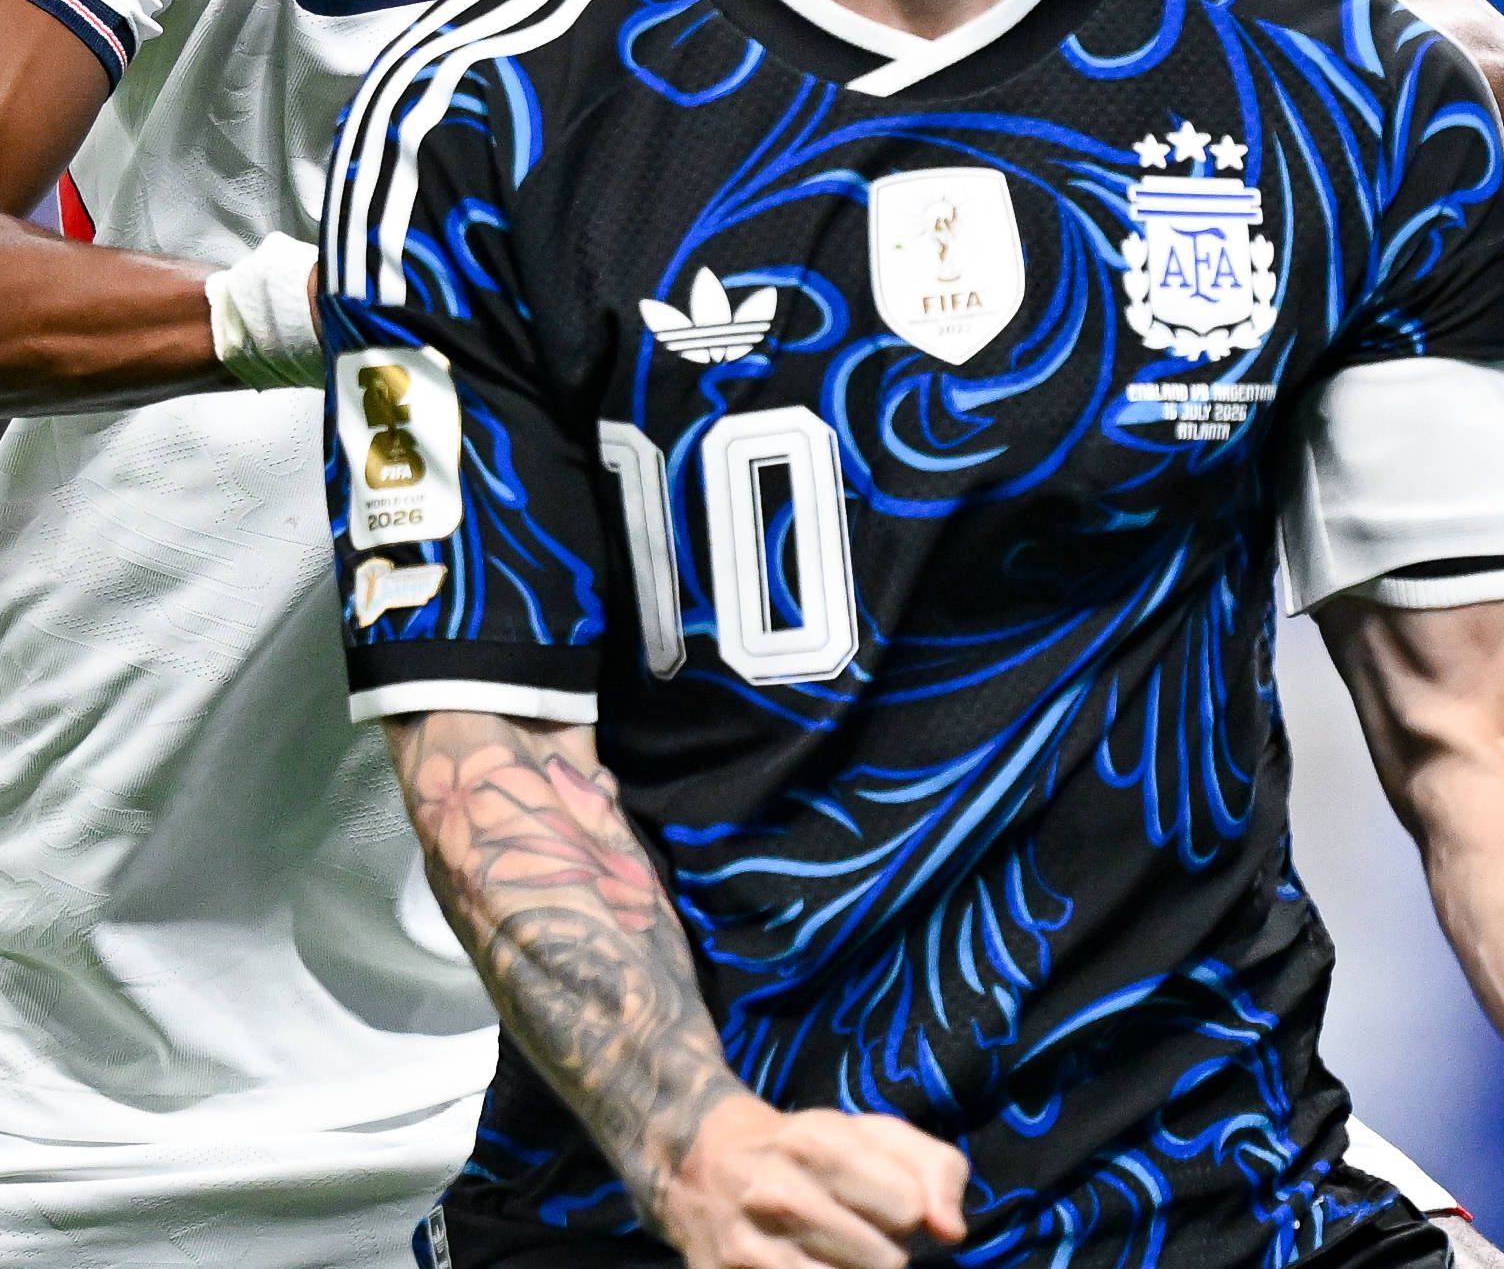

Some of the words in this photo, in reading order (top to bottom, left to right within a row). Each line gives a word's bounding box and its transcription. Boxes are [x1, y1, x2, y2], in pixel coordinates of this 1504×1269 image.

[1160, 227, 1242, 303] AFA
[922, 291, 983, 314] FIFA
[1180, 402, 1211, 421] JULY
[368, 509, 423, 531] 2026
[597, 405, 860, 686] 10
